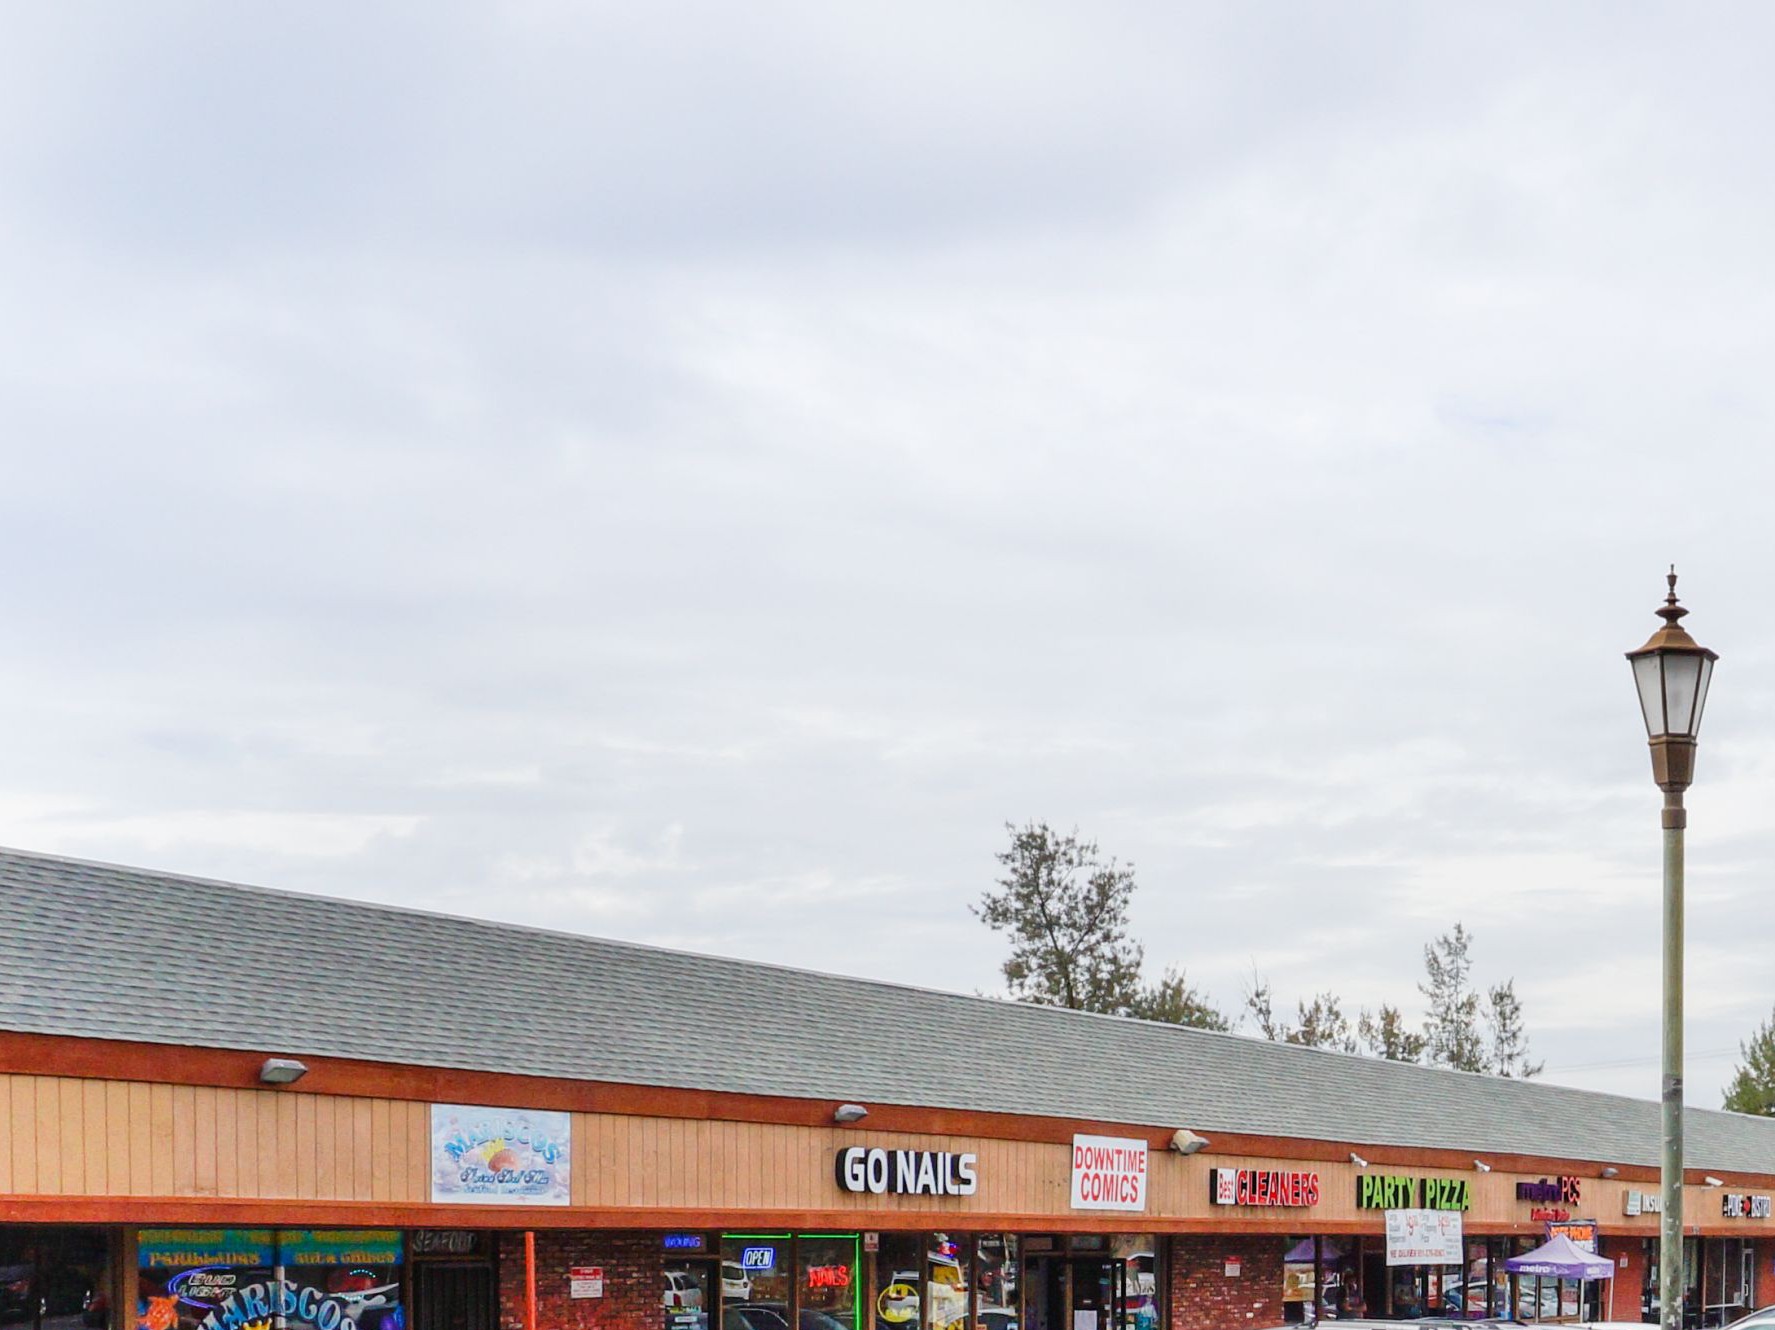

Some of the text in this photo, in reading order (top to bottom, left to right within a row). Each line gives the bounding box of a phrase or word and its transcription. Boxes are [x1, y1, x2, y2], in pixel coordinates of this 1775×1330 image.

[445, 1118, 560, 1164] MARISCOS
[845, 1147, 977, 1196] GO NAILS
[1075, 1145, 1145, 1173] DOWNTIME
[1080, 1172, 1140, 1203] COMICS
[1219, 1168, 1319, 1207] Best CLEANERS
[1362, 1174, 1469, 1211] PARTY PIZZA
[745, 1250, 772, 1266] OPEN
[187, 1273, 237, 1286] BUD
[808, 1264, 850, 1288] NAILS
